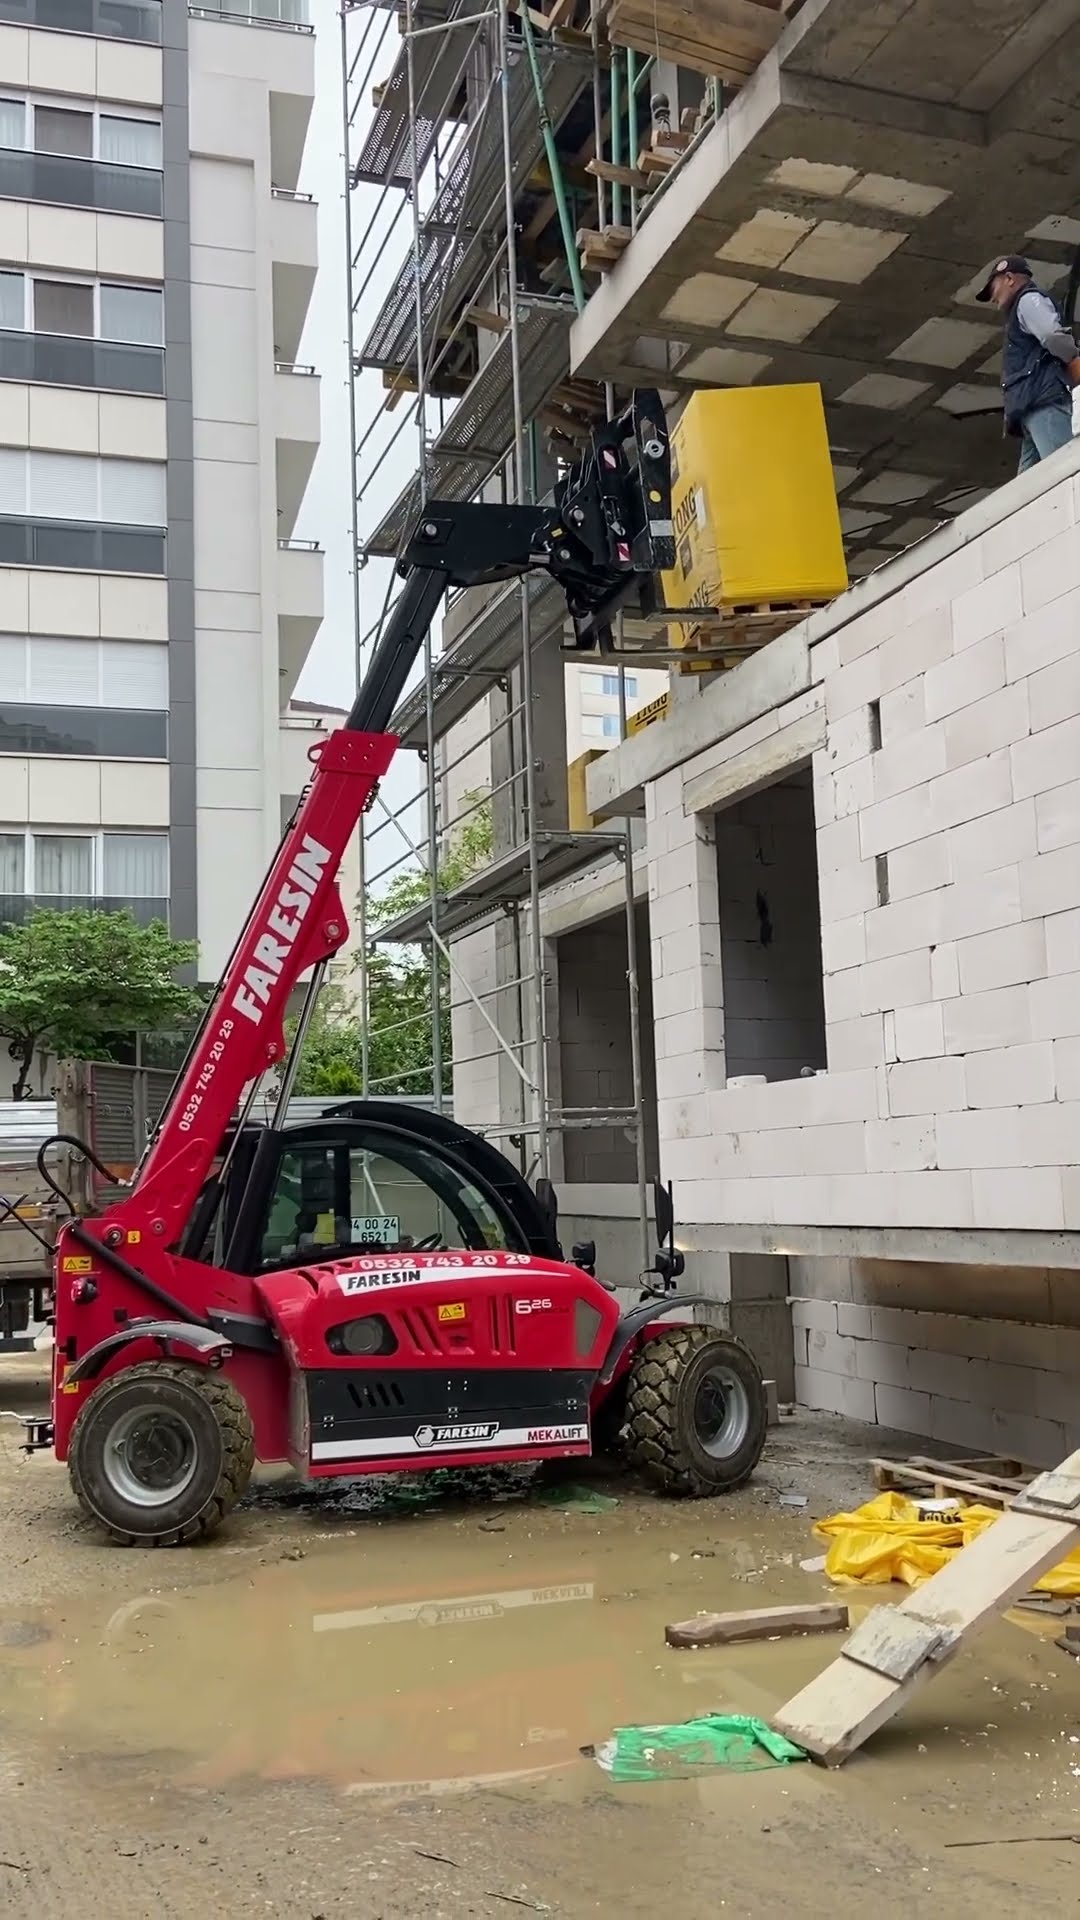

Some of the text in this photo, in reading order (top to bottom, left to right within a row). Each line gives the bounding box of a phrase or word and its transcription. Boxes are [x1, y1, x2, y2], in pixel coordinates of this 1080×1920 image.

[231, 833, 332, 1026] FARESIN
[179, 1019, 234, 1131] 0532 743 20 29
[350, 1219, 359, 1230] 4
[383, 1218, 396, 1229] 24
[361, 1231, 388, 1243] 6521
[359, 1254, 531, 1270] 0532 743 20 29
[347, 1270, 421, 1290] FARESIN
[437, 1425, 490, 1440] FARESIN
[527, 1427, 583, 1441] MEKALIFT
